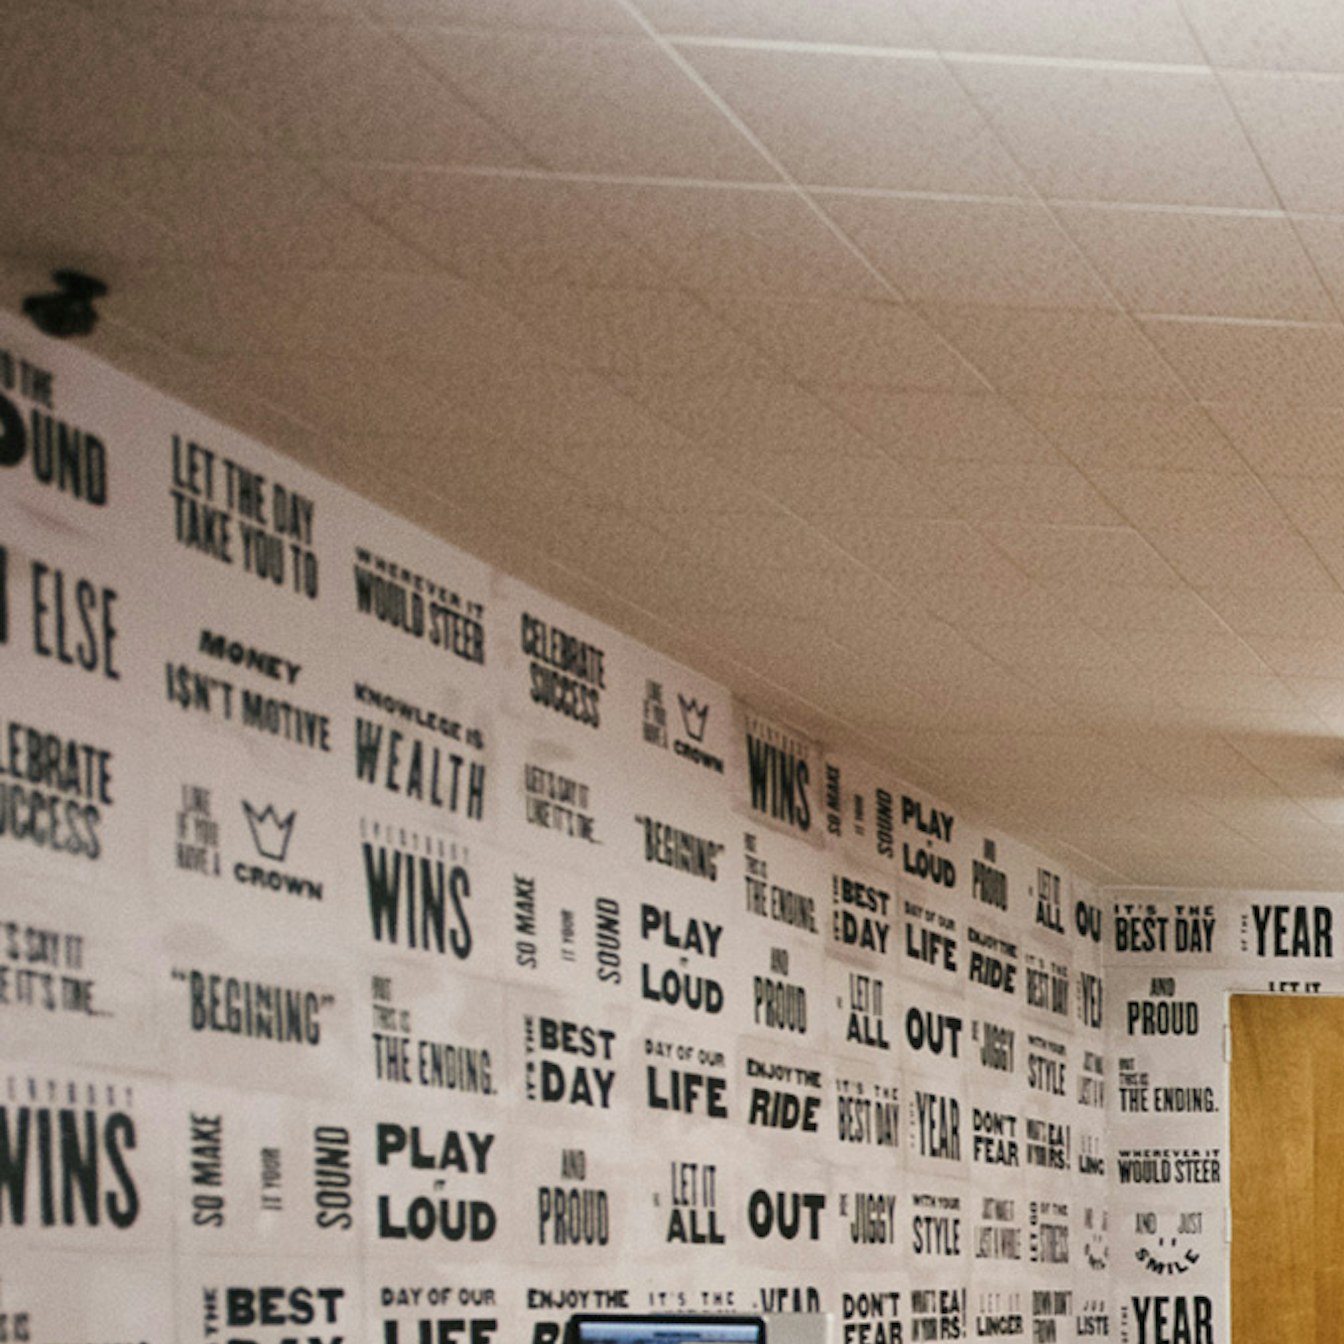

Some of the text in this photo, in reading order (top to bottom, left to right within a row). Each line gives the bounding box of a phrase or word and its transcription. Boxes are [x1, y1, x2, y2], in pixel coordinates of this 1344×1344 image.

[172, 434, 314, 543] LET THE DAY
[171, 491, 317, 599] TAKE YOU TO
[29, 559, 121, 681] ELSE
[355, 565, 484, 665] WOULD STEER
[200, 630, 301, 684] MONEY
[243, 690, 330, 752] MOTIVE
[355, 718, 485, 821] WEALTH
[875, 787, 894, 859] SOUND
[901, 796, 953, 842] PLAY
[234, 863, 323, 900] CROWN
[903, 843, 955, 888] LOUD
[363, 842, 472, 960] WINS
[841, 878, 890, 915] BEST
[595, 897, 621, 985] SOUND
[641, 903, 723, 958] PLAY
[842, 911, 890, 953] DAY
[906, 923, 957, 972] LIFE
[1114, 915, 1216, 953] BEST DAY
[1251, 904, 1333, 958] YEAR
[641, 963, 723, 1014] LOUD
[969, 951, 1016, 994] RIDE
[753, 975, 807, 1035] PROUD
[1126, 1000, 1199, 1036] PROUD
[539, 1018, 615, 1060] BEST
[846, 1011, 890, 1051] ALL
[905, 1006, 963, 1059] OUT
[372, 1033, 411, 1081] THE
[1028, 1054, 1065, 1096] STYLE
[541, 1061, 615, 1108] DAY
[647, 1066, 728, 1118] LIFE
[1118, 1084, 1149, 1113] THE
[748, 1088, 821, 1131] RIDE
[914, 1090, 961, 1161] YEAR
[973, 1108, 1016, 1137] DON'T
[376, 1122, 495, 1175] PLAY
[974, 1135, 1019, 1166] FEAR
[1117, 1158, 1221, 1184] WOULD STEER
[314, 1126, 353, 1230] SOUND
[377, 1194, 498, 1243] LOUD
[538, 1186, 609, 1247] PROUD
[666, 1207, 726, 1245] ALL
[747, 1188, 827, 1241] OUT
[912, 1214, 961, 1256] STYLE
[1135, 1247, 1200, 1276] SMILE
[225, 1286, 345, 1328] BEST
[842, 1291, 901, 1320] DON'T
